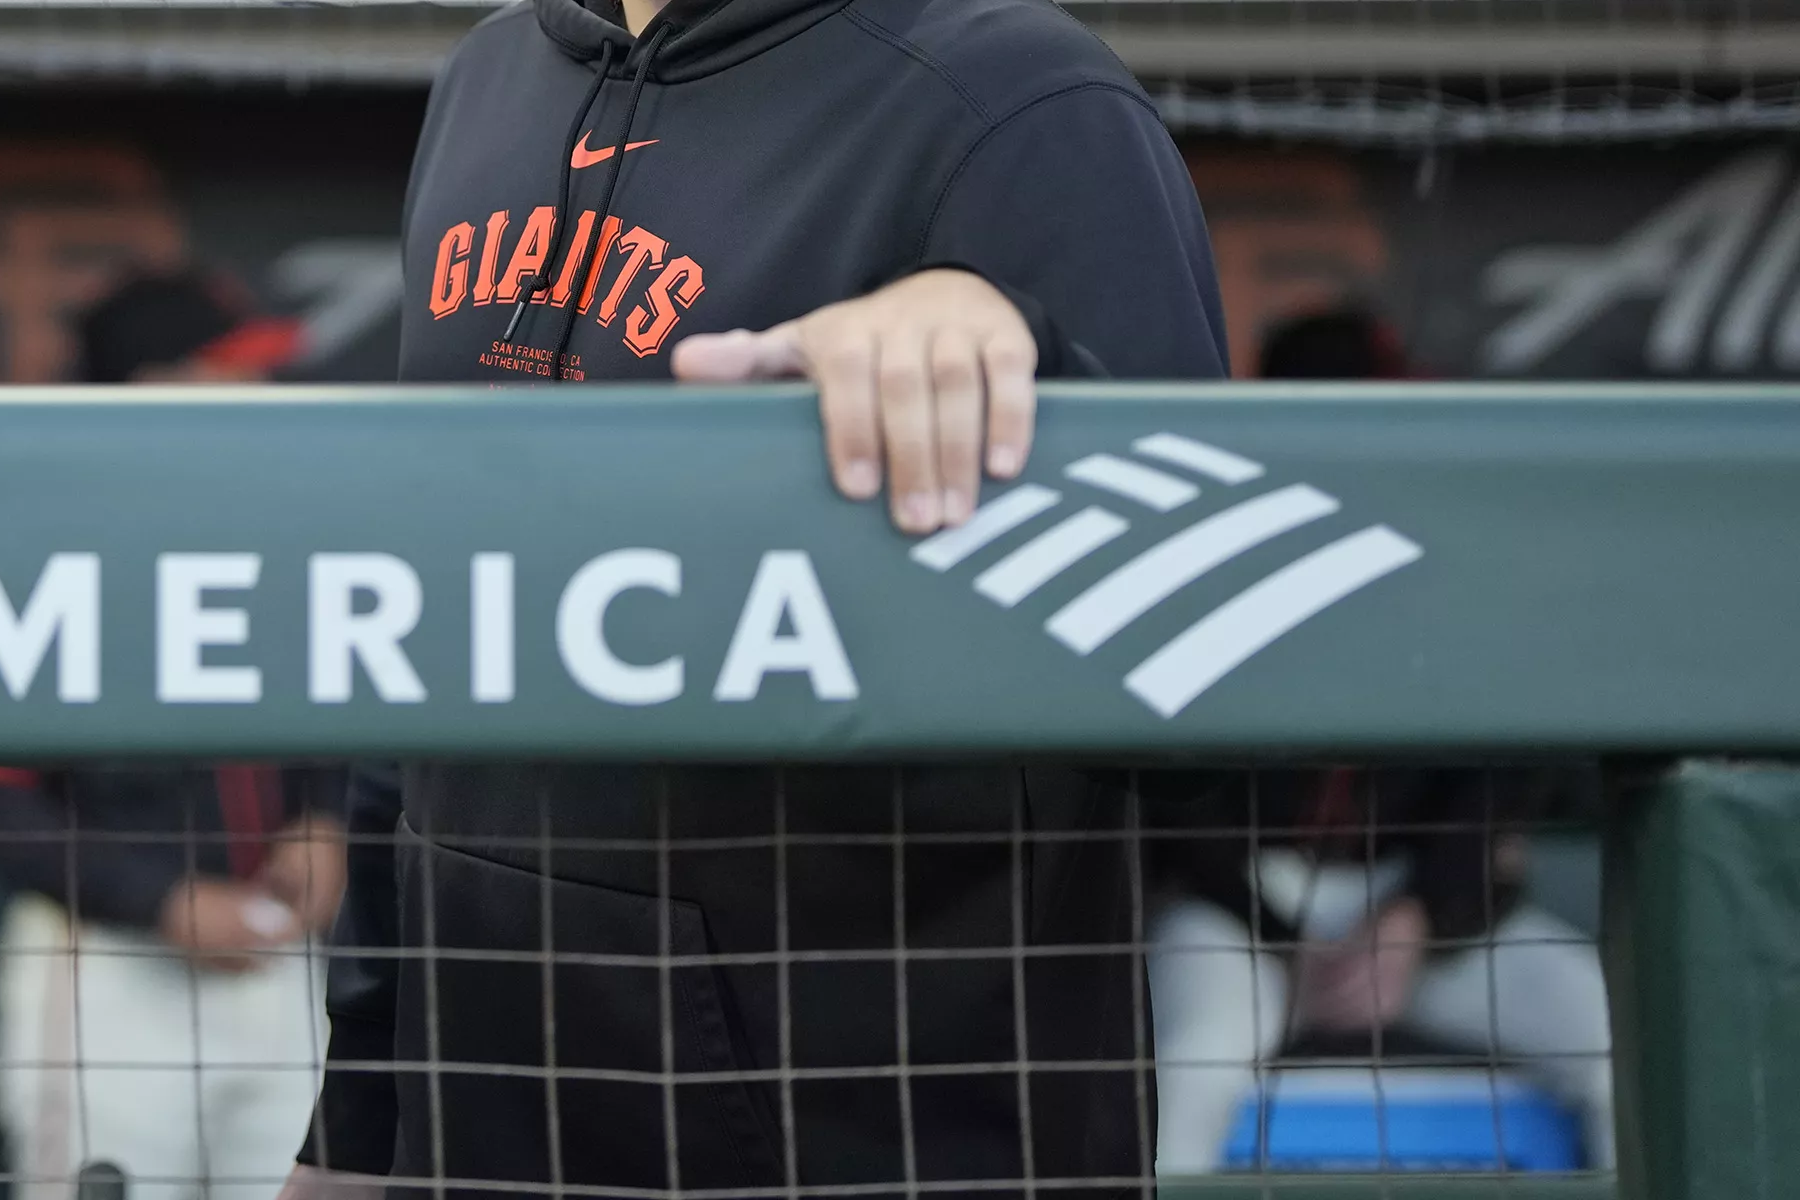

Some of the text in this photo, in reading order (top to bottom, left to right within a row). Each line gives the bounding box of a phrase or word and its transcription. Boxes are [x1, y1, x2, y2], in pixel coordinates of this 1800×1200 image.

[428, 205, 706, 358] GIANTS
[478, 352, 585, 381] AUTHENTIC COECTION
[491, 340, 581, 366] SAN FRANCISO, CA
